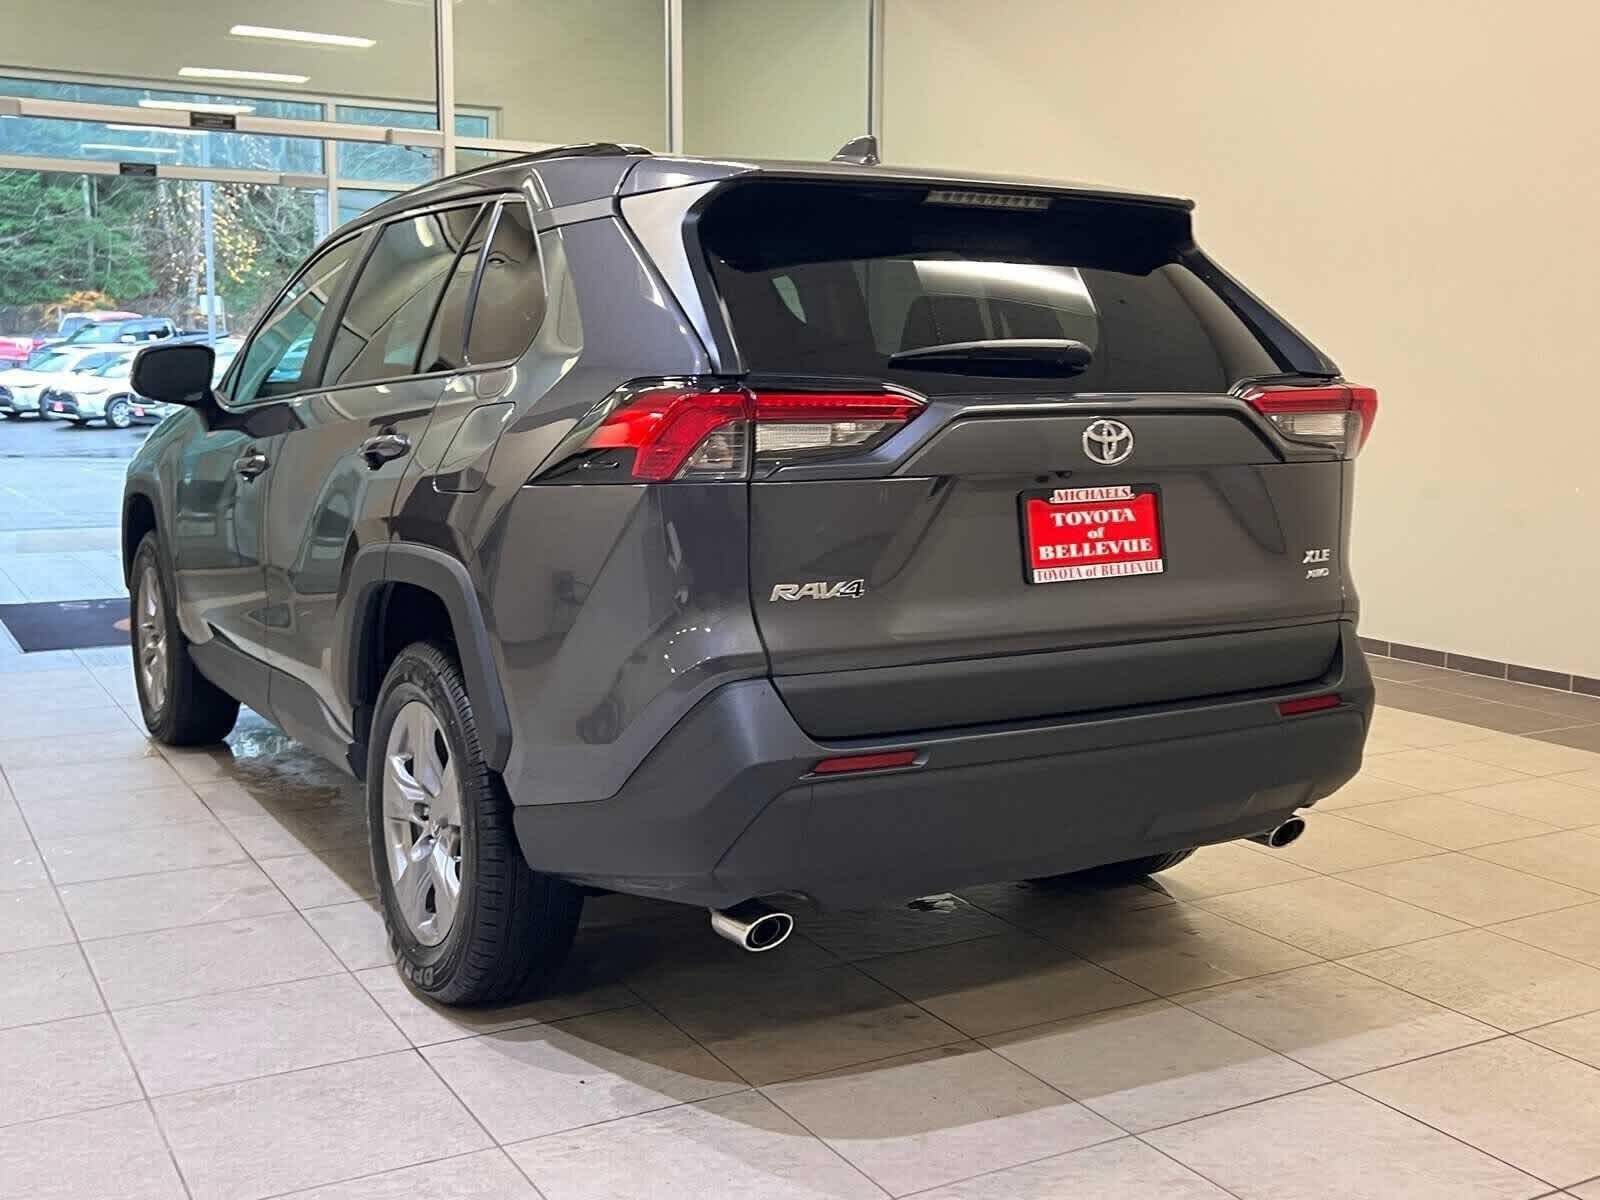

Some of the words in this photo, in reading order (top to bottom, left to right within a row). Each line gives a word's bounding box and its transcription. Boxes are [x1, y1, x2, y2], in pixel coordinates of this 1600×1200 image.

[1056, 487, 1130, 501] MICHAELS
[1050, 508, 1136, 527] TOYOTA
[1087, 526, 1105, 539] of
[1038, 538, 1153, 560] BELLEVUE
[1302, 548, 1330, 563] XLE
[1036, 567, 1082, 582] TOYOTA
[1086, 565, 1097, 576] of
[1101, 560, 1161, 577] BELLEVUE
[769, 579, 865, 602] RAV4
